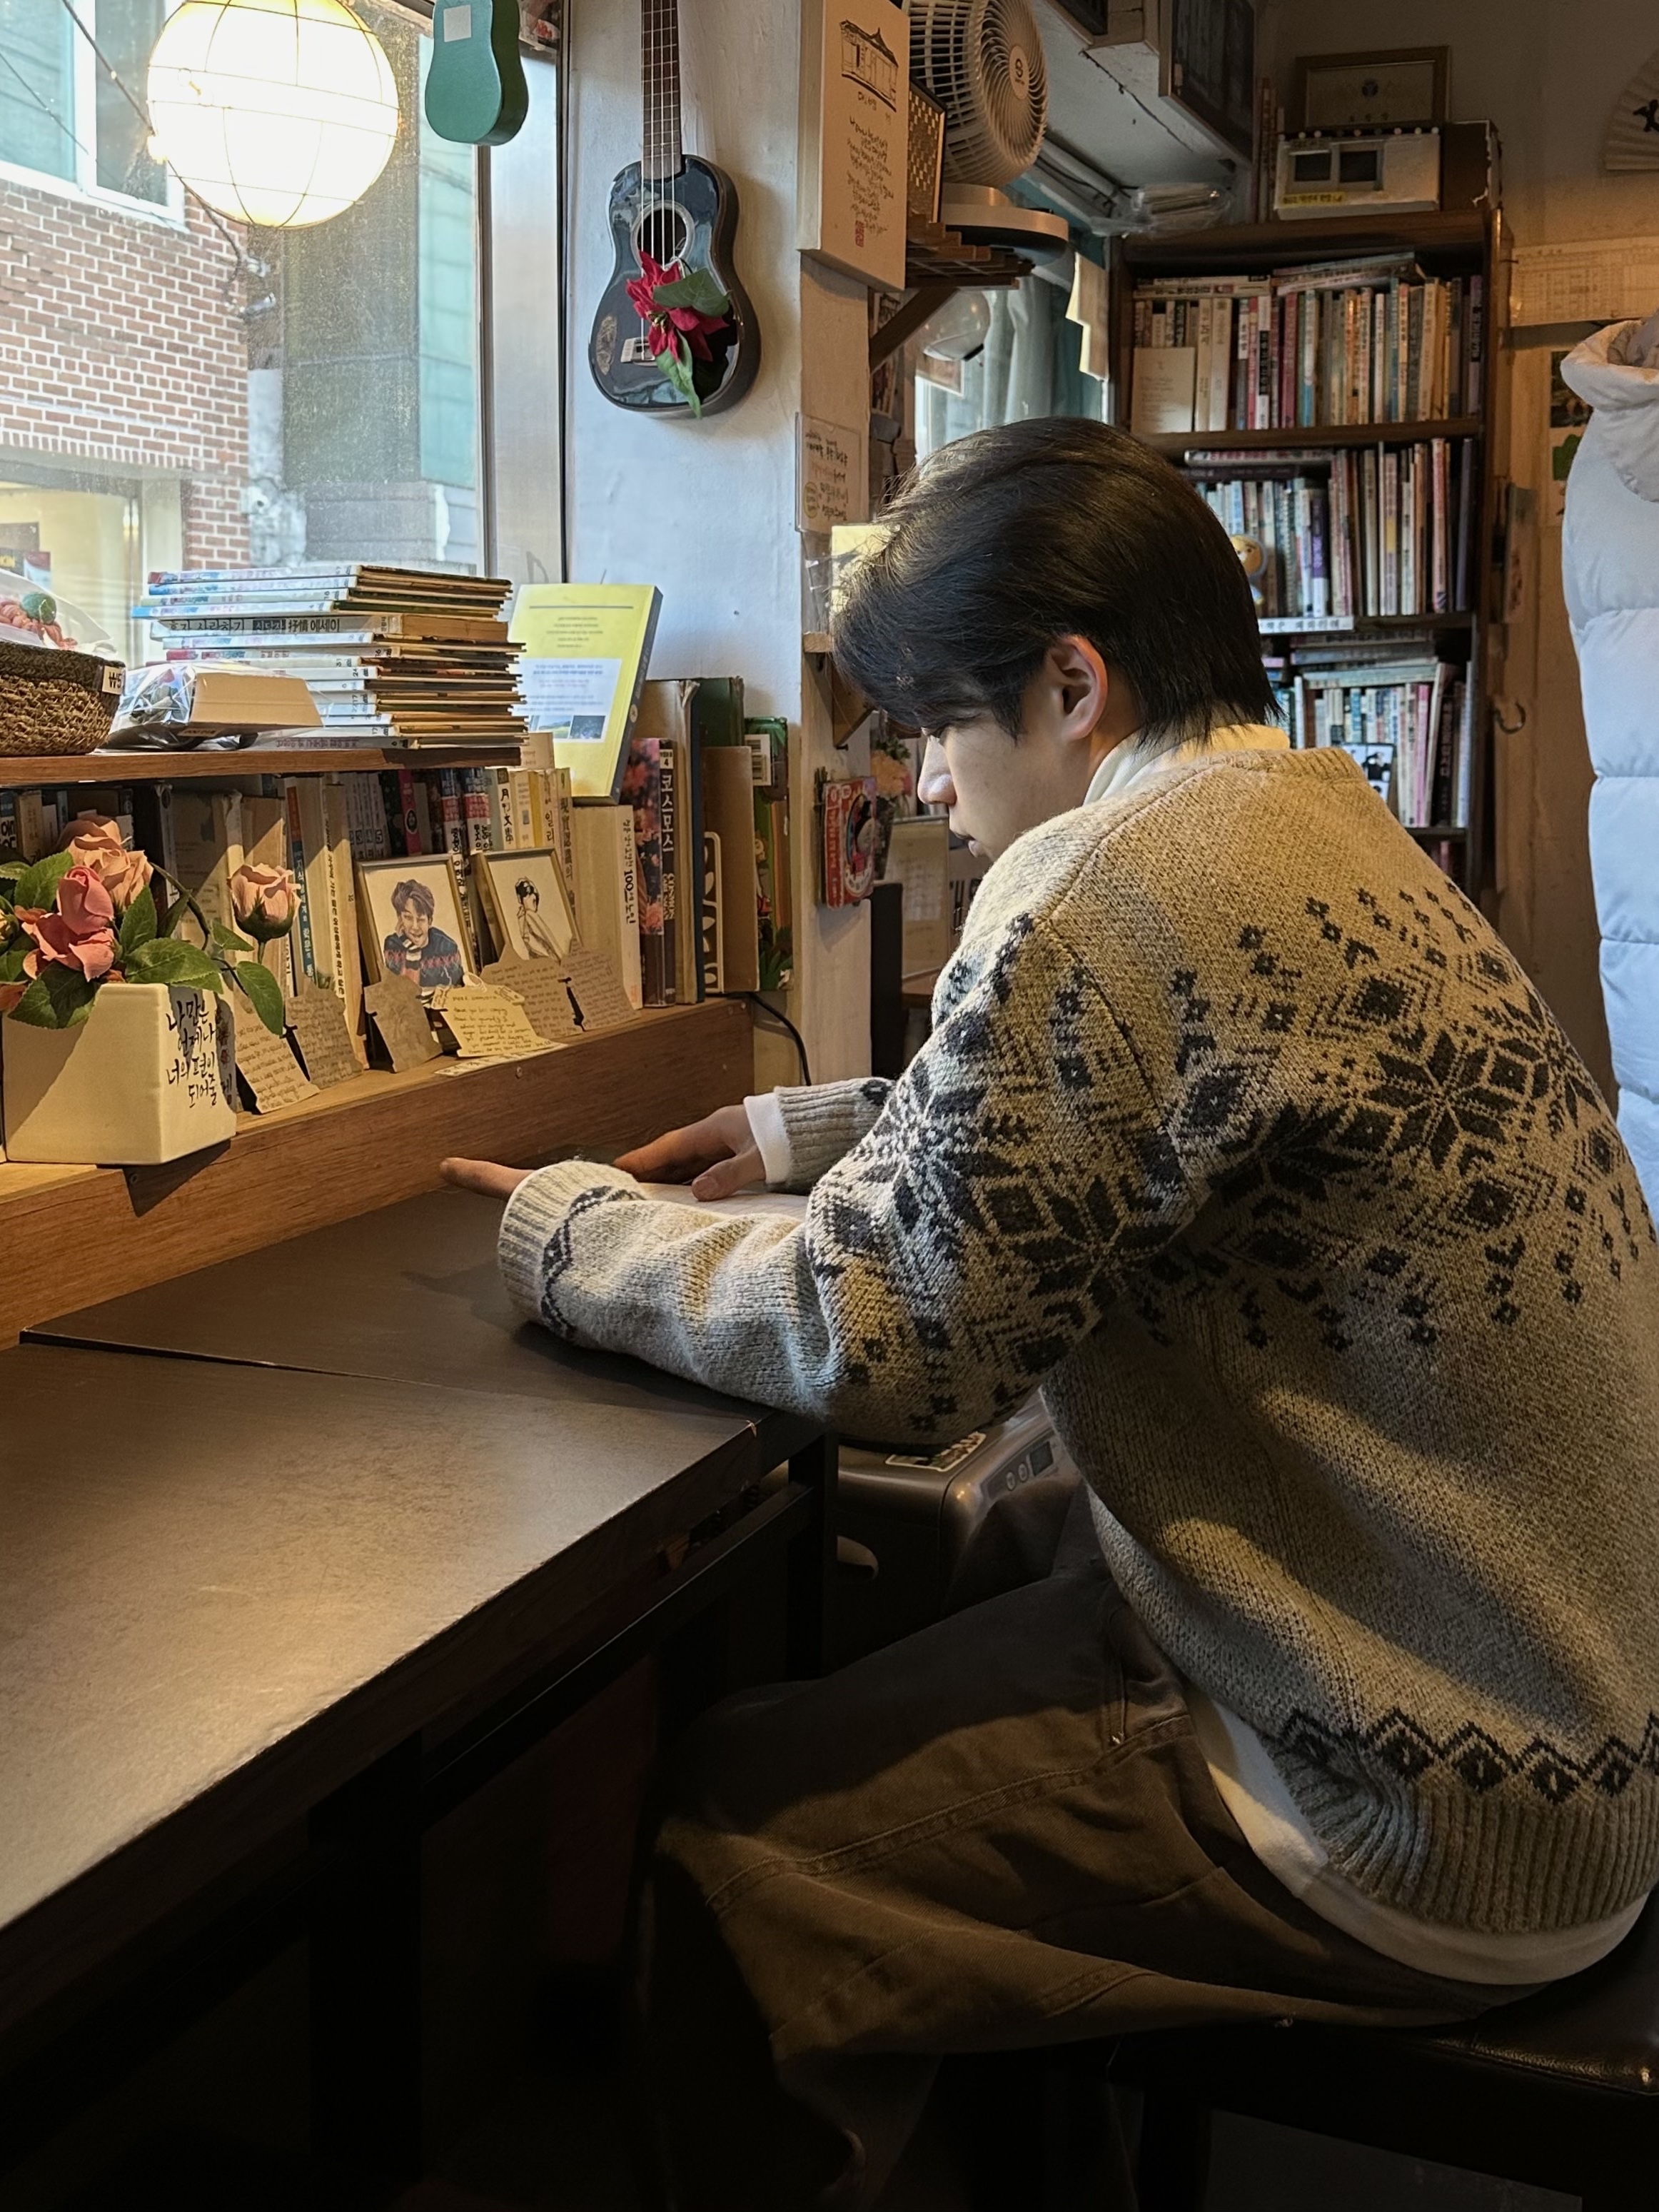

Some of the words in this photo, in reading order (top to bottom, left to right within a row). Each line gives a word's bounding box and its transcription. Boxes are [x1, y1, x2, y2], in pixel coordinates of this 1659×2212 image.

[311, 618, 340, 632] 에세이
[660, 773, 675, 853] 코스모스
[375, 830, 382, 842] 5
[166, 993, 210, 1031] 나만은
[178, 1022, 216, 1057] 언제나
[166, 1058, 191, 1087] 너의
